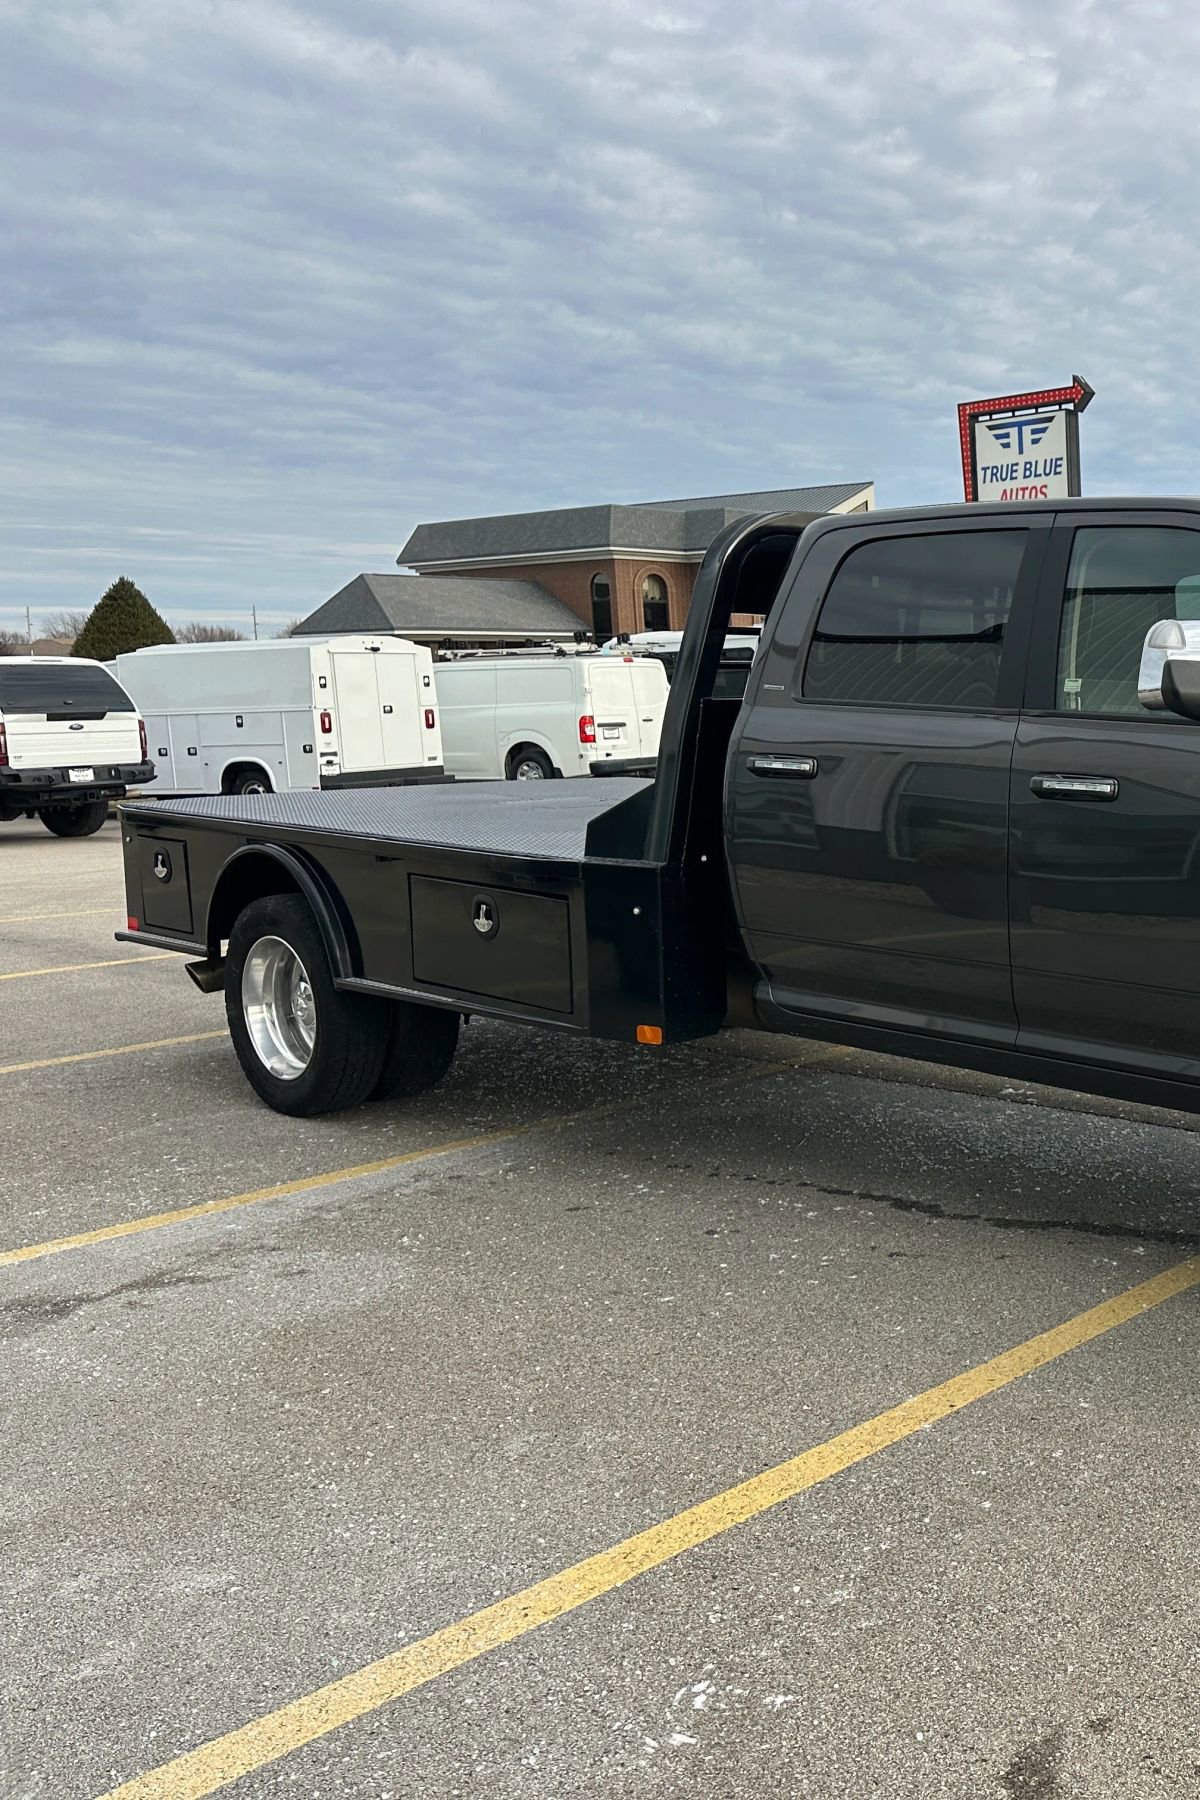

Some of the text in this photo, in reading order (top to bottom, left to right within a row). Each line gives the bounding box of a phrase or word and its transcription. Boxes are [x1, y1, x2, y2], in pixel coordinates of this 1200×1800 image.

[981, 457, 1063, 484] TRUE BLUE
[1000, 484, 1048, 500] AUTOS
